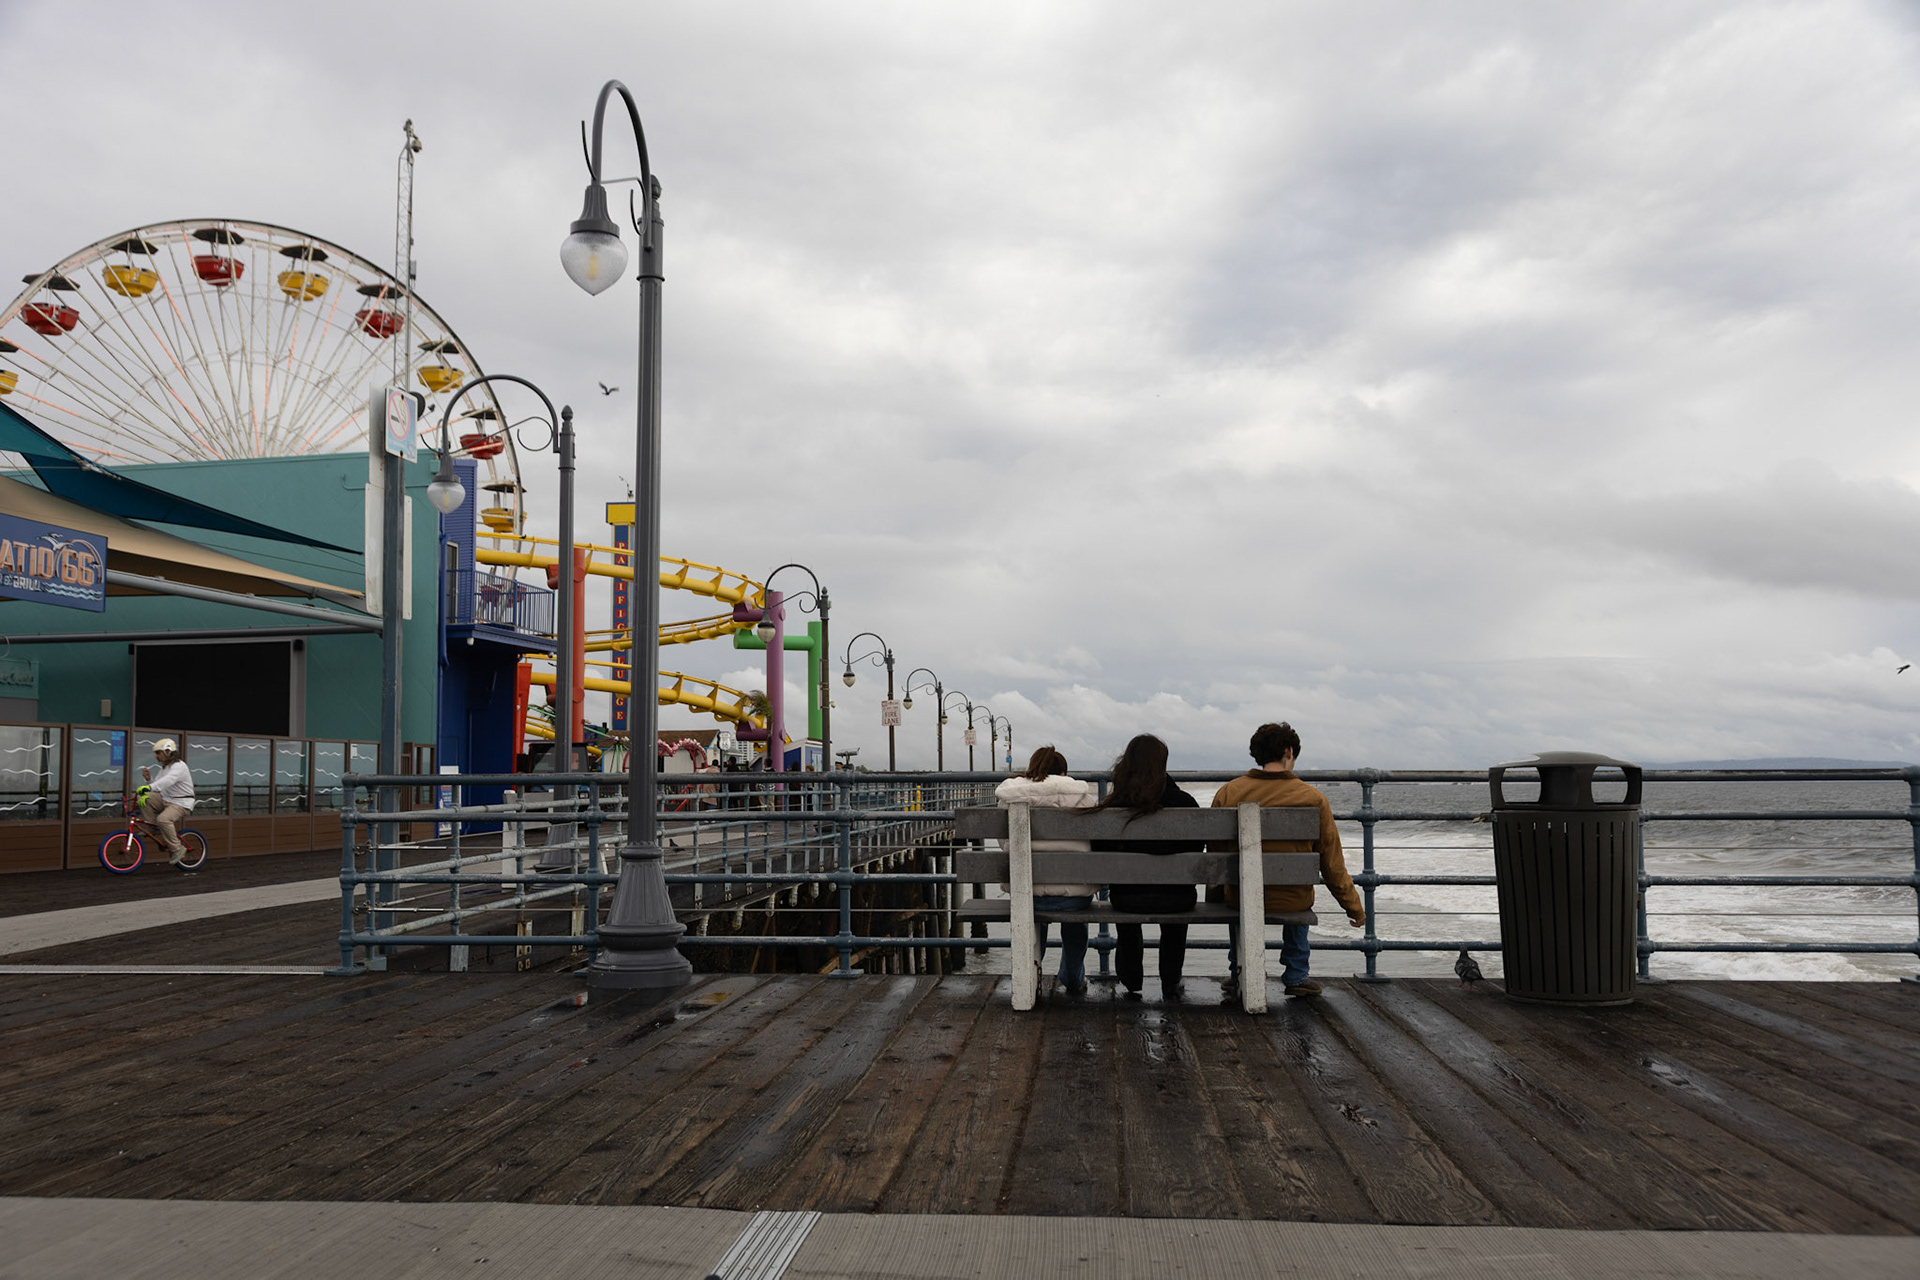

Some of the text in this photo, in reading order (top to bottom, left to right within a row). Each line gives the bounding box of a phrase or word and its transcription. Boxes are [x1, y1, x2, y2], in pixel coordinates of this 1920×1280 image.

[13, 576, 41, 592] GRILL
[61, 548, 95, 587] 66
[617, 542, 625, 630] PAIFIC
